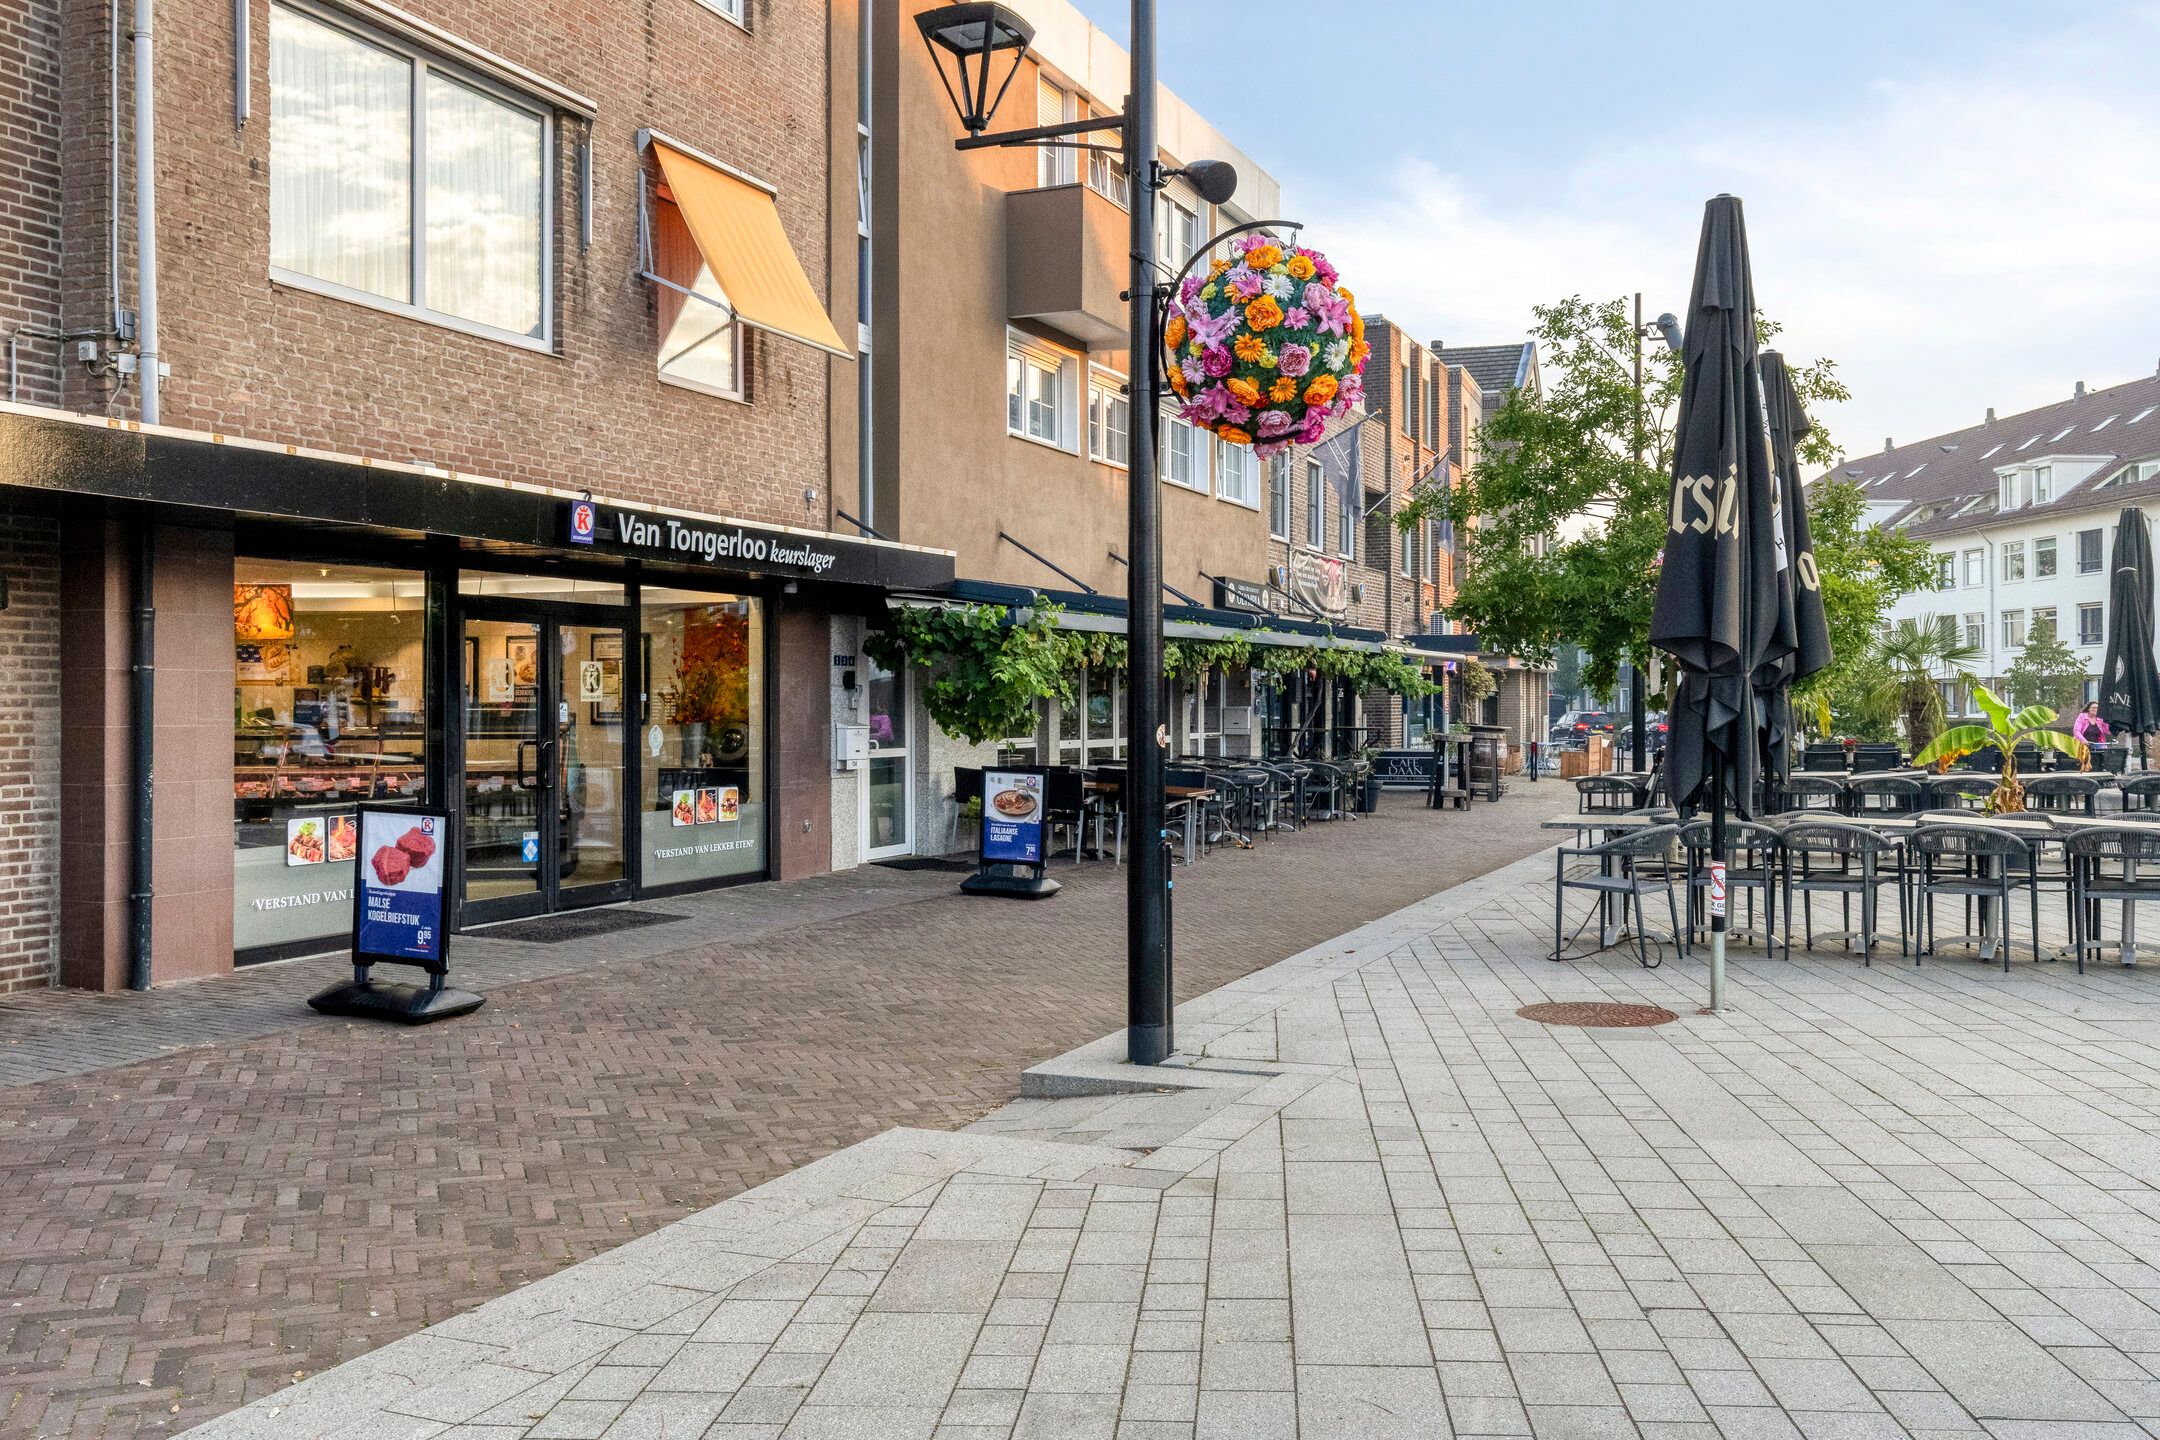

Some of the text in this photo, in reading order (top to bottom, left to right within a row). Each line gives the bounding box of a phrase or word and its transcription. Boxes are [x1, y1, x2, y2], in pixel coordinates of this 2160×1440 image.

[1669, 463, 1739, 540] rsi
[577, 512, 590, 531] K
[618, 512, 835, 574] Van Tongerloo keurslager
[585, 671, 599, 690] K
[1388, 766, 1423, 775] DAAN
[990, 827, 1019, 836] ITALIAANSE
[990, 834, 1012, 842] LASAGNE
[654, 846, 694, 859] 'VERSTAND
[695, 844, 710, 854] VAN
[710, 841, 735, 852] LEKKER
[251, 888, 355, 911] 'VERSTAND VAN L
[368, 896, 391, 909] MALSE
[367, 910, 420, 926] KOGELBIEFSTUK
[417, 930, 432, 945] 9.95
